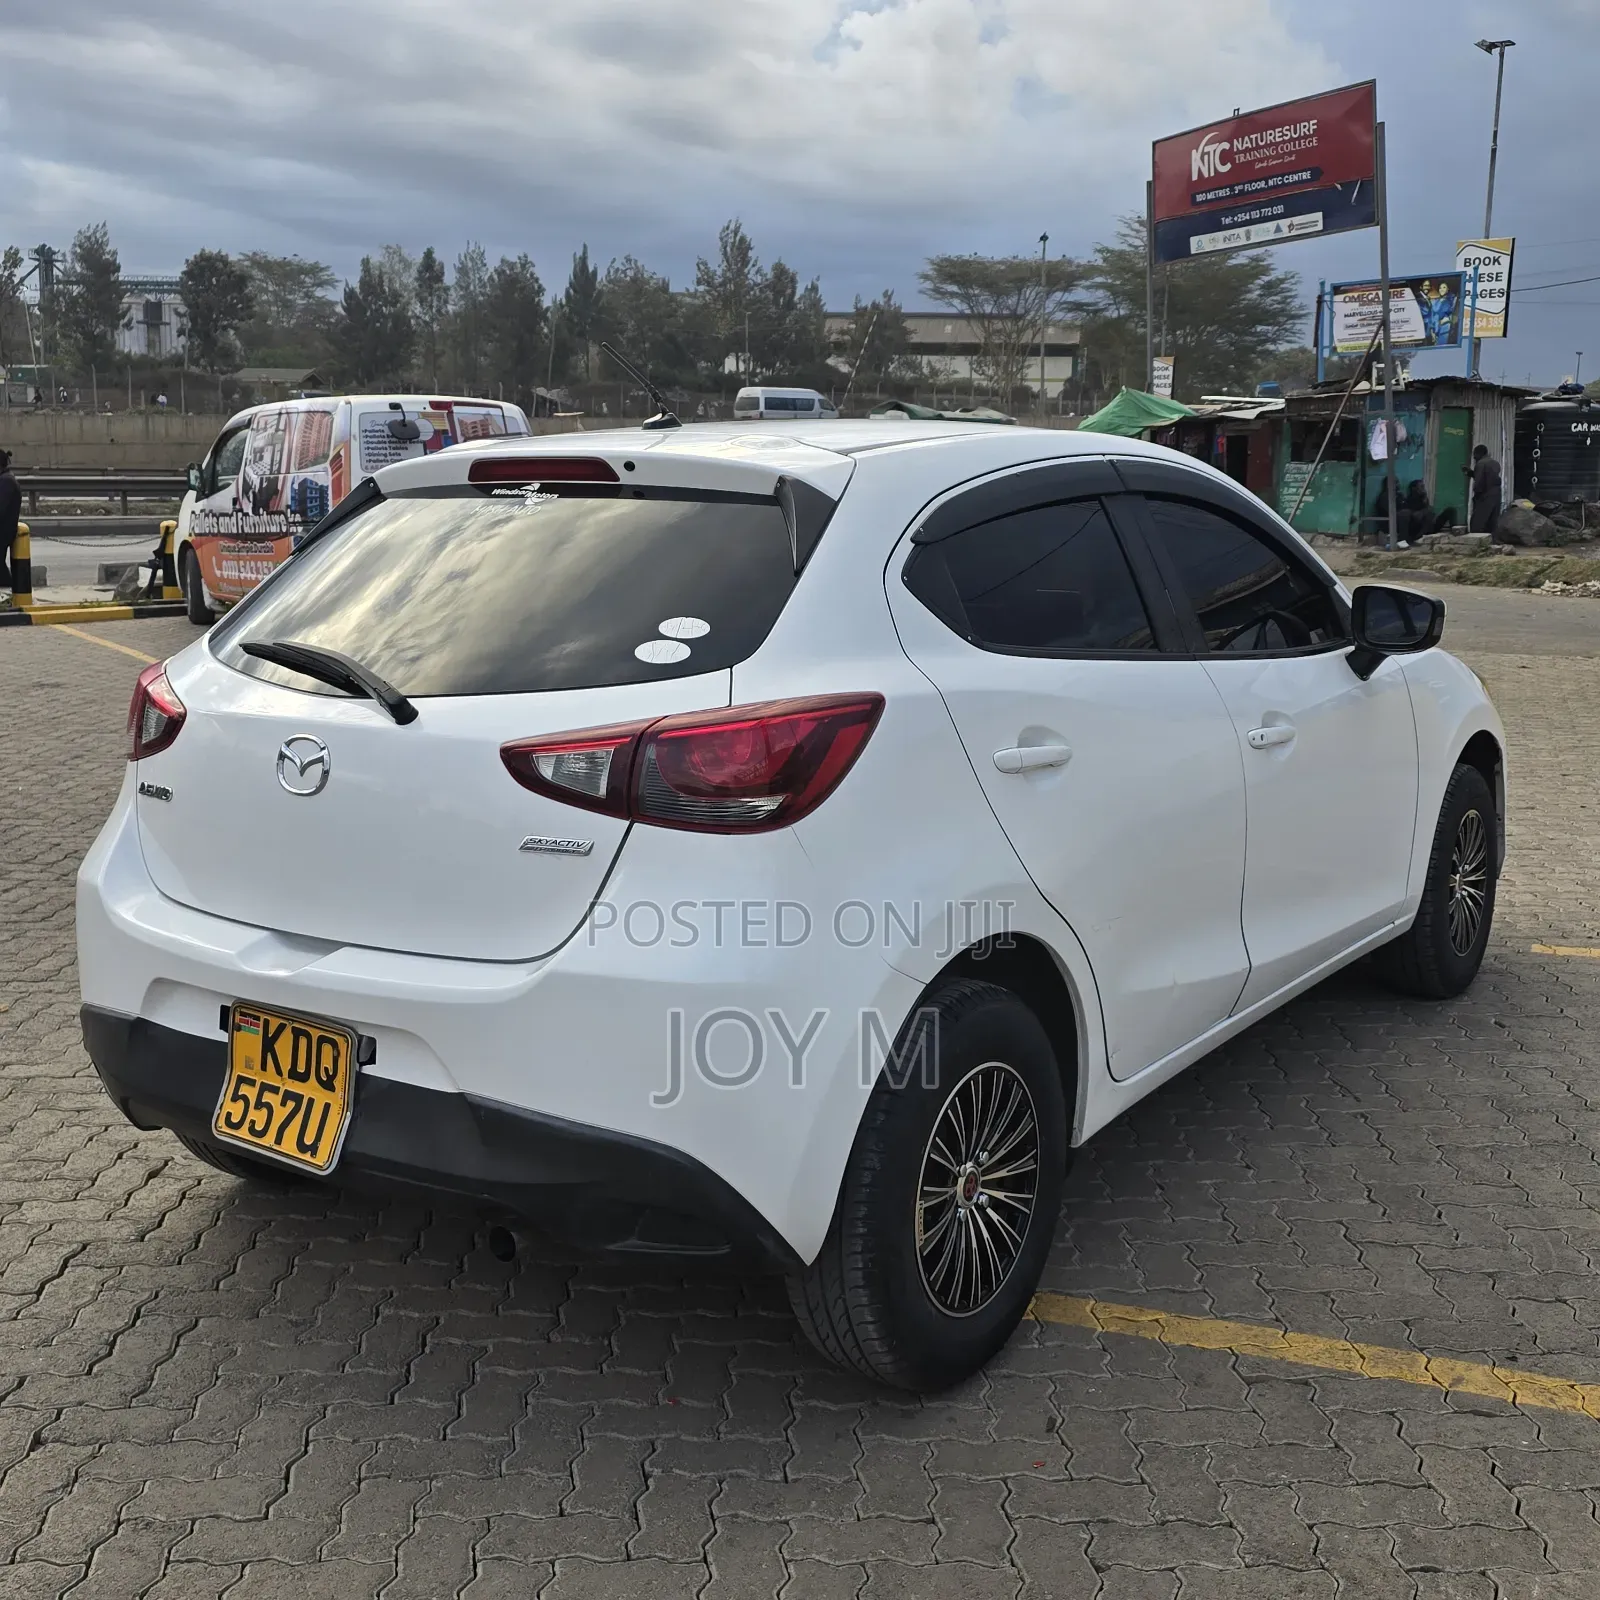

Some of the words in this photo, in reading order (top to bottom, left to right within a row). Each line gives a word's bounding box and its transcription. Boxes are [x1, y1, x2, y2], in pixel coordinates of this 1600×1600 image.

[1233, 120, 1318, 152] NATURESURF
[1191, 132, 1232, 181] NTC
[1234, 146, 1277, 164] TRAINING
[1278, 137, 1319, 153] COLLEGE
[1207, 188, 1231, 199] METRES
[1244, 181, 1268, 192] FLOOR,
[1268, 177, 1283, 187] NTC
[1284, 171, 1312, 183] CENTRE
[1464, 255, 1502, 268] BOOK
[1466, 272, 1503, 283] ESE
[1343, 292, 1380, 304] OMEGA
[1571, 422, 1588, 432] CAR
[190, 510, 218, 534] Pallets
[218, 511, 237, 533] and
[238, 508, 287, 533] Furniture
[527, 837, 587, 848] SKYACTIV
[260, 1017, 340, 1093] KDQ
[224, 1073, 331, 1159] 557U
